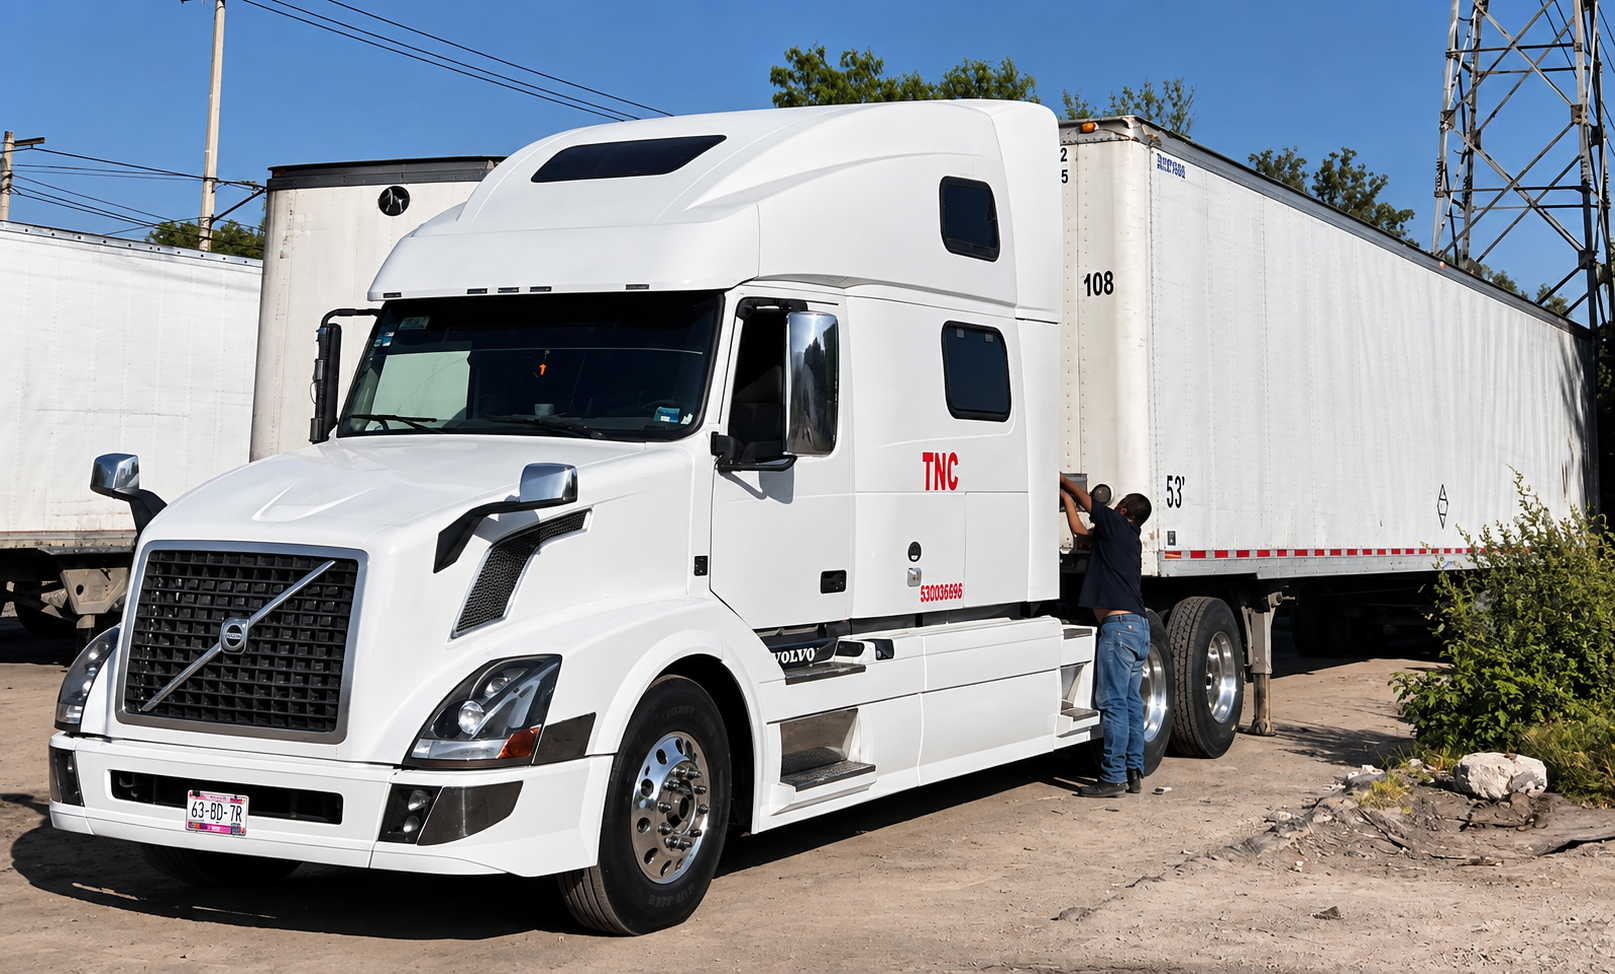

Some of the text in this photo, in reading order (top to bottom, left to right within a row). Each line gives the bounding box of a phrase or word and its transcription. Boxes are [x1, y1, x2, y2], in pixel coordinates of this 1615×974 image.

[1083, 270, 1114, 297] 108
[922, 451, 959, 491] TNC
[1166, 475, 1185, 508] 53'
[773, 647, 816, 664] VOLVO
[191, 801, 243, 822] 63-BD-7R
